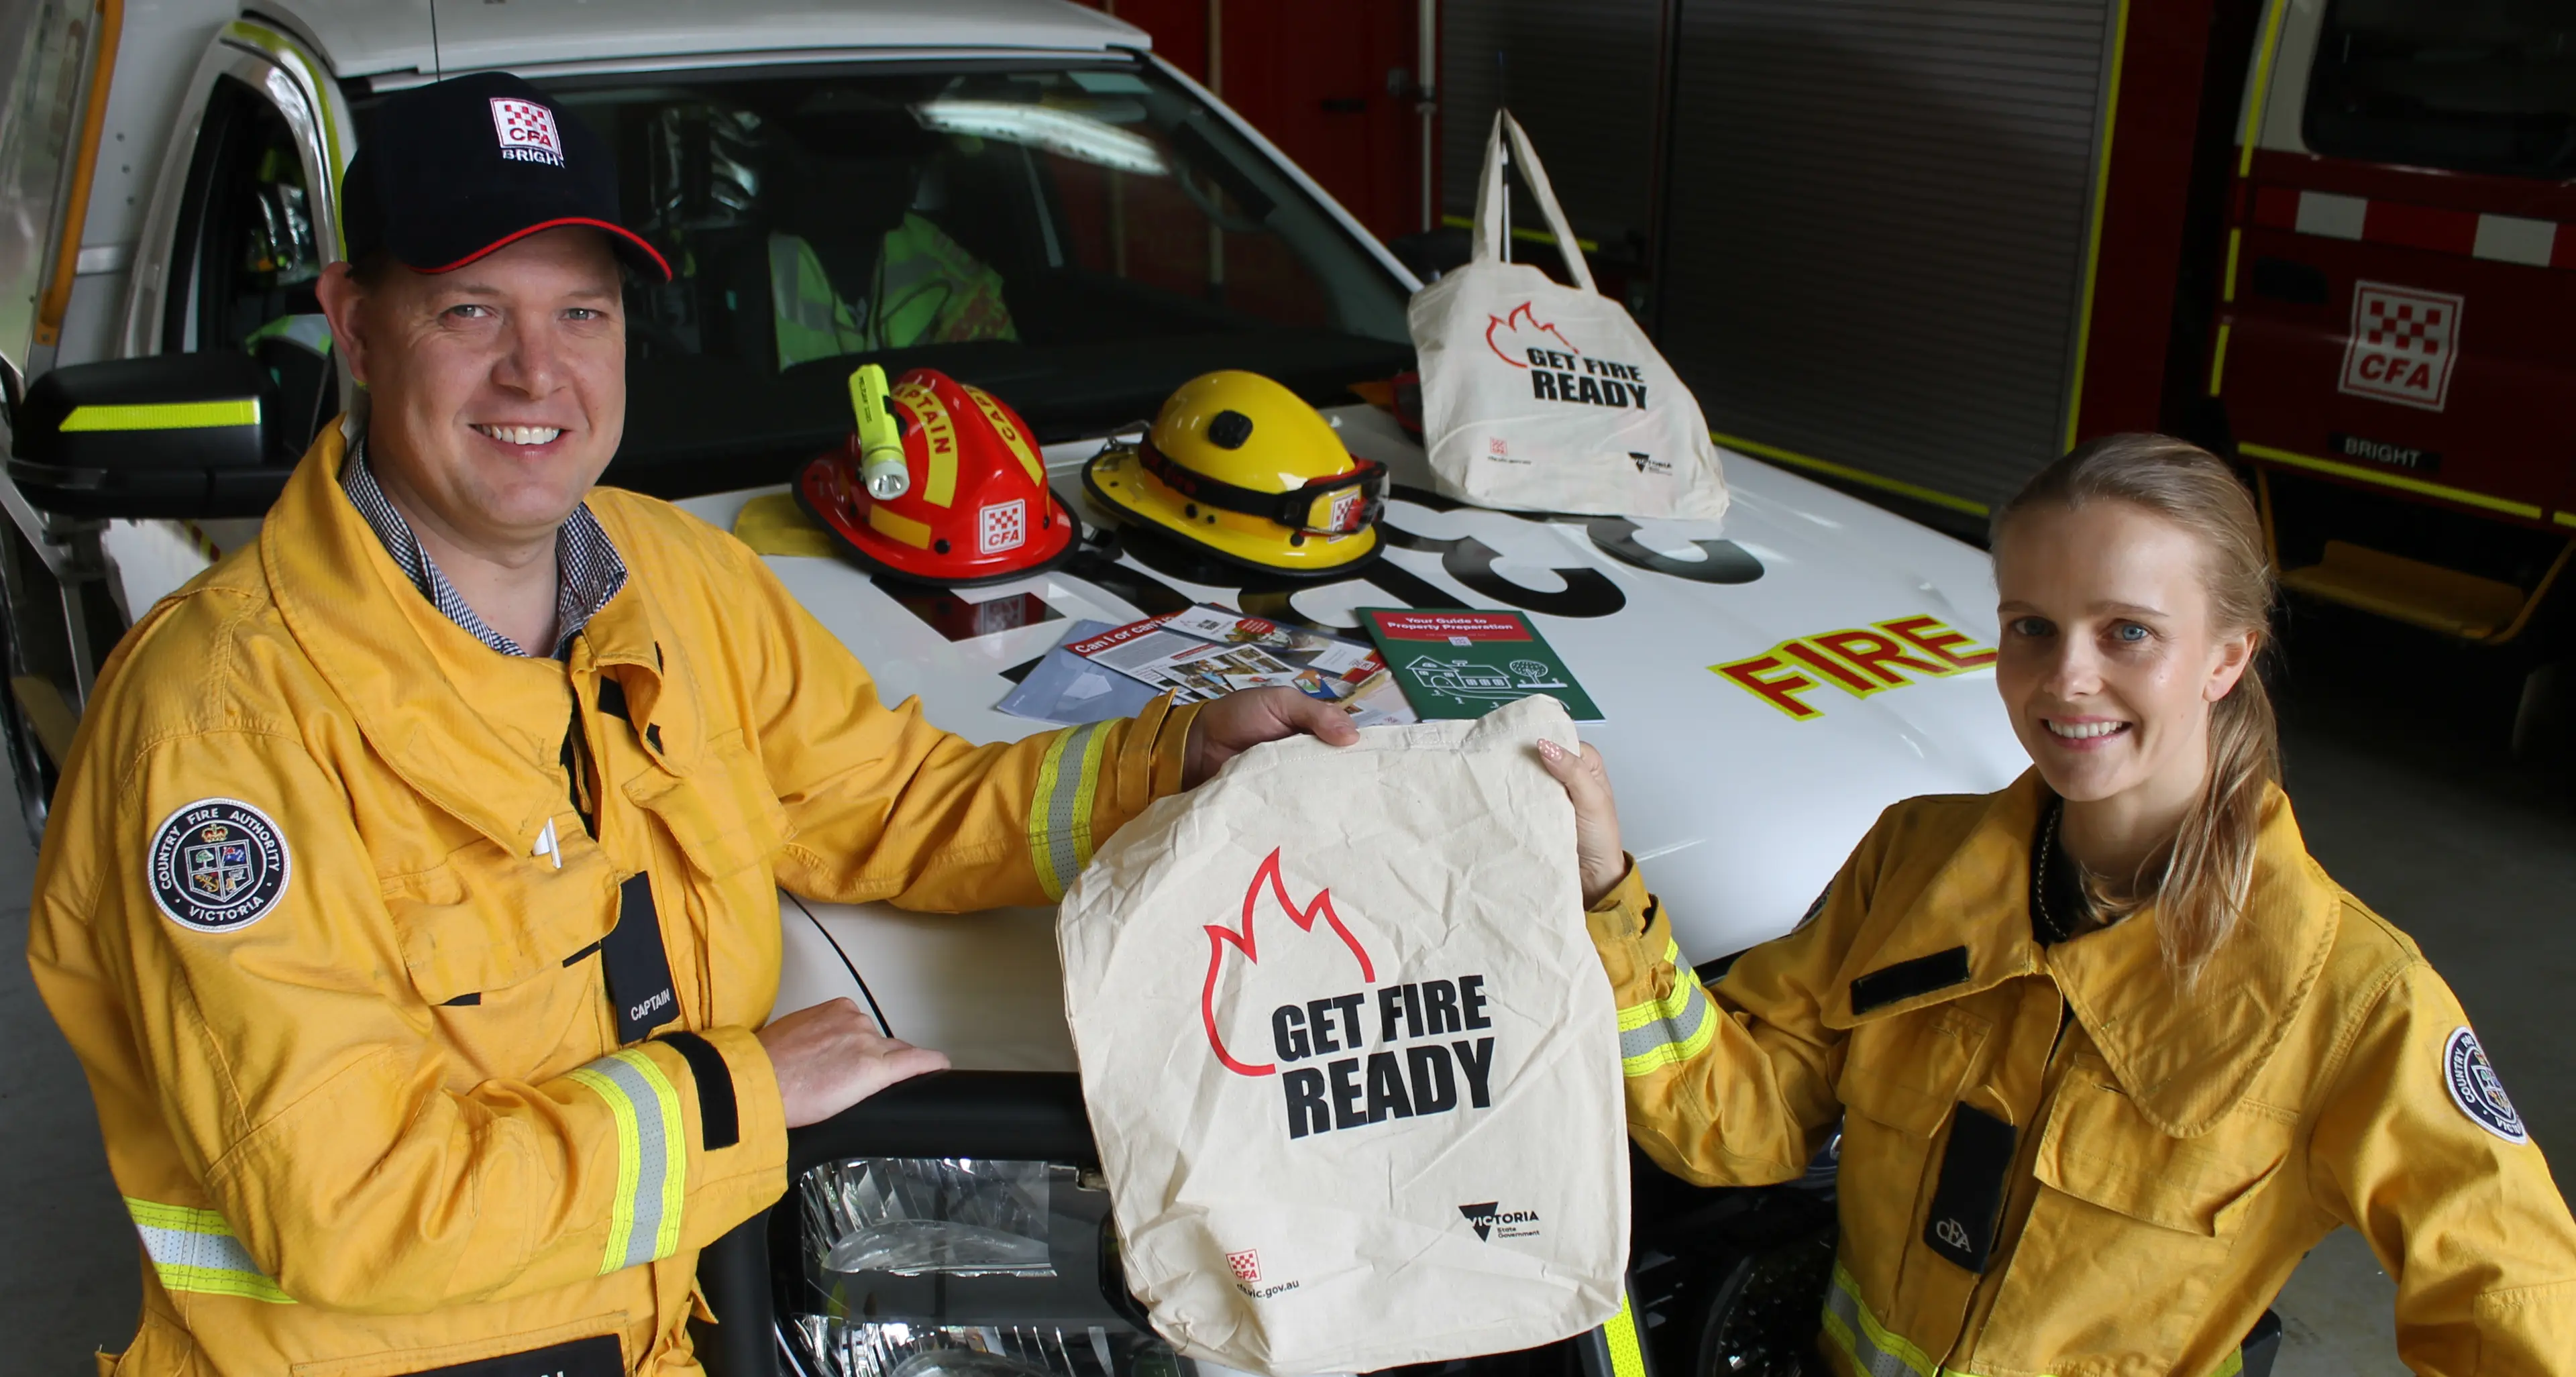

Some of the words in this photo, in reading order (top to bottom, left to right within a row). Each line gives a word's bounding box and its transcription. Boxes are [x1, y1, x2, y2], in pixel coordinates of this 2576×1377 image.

[510, 127, 552, 148] CFA
[1526, 347, 1576, 370] GET
[1583, 357, 1646, 383] FIRE
[2359, 353, 2430, 390] CFA
[1531, 370, 1647, 410] READY
[2344, 437, 2421, 468] BRIGHT
[988, 529, 1020, 547] CFA
[1075, 639, 1106, 654] Can
[1103, 635, 1116, 643] I
[1114, 630, 1133, 639] or
[1387, 621, 1440, 631] Property
[1707, 614, 1996, 721] FIRE
[158, 826, 181, 890] COUNTRY
[186, 808, 219, 825] FIRE
[229, 810, 281, 872] AUTHORITY
[189, 896, 264, 922] VICTORIA
[631, 988, 671, 1021] CAPTAIN
[1272, 993, 1364, 1062] GET
[1377, 975, 1491, 1043] FIRE
[1282, 1036, 1495, 1140] READY
[2453, 1047, 2475, 1103] COUNTRY
[1466, 1211, 1540, 1227] VICTORIA
[1498, 1230, 1540, 1238] Government
[1936, 1218, 1972, 1253] CFA
[1235, 1270, 1257, 1279] CFA
